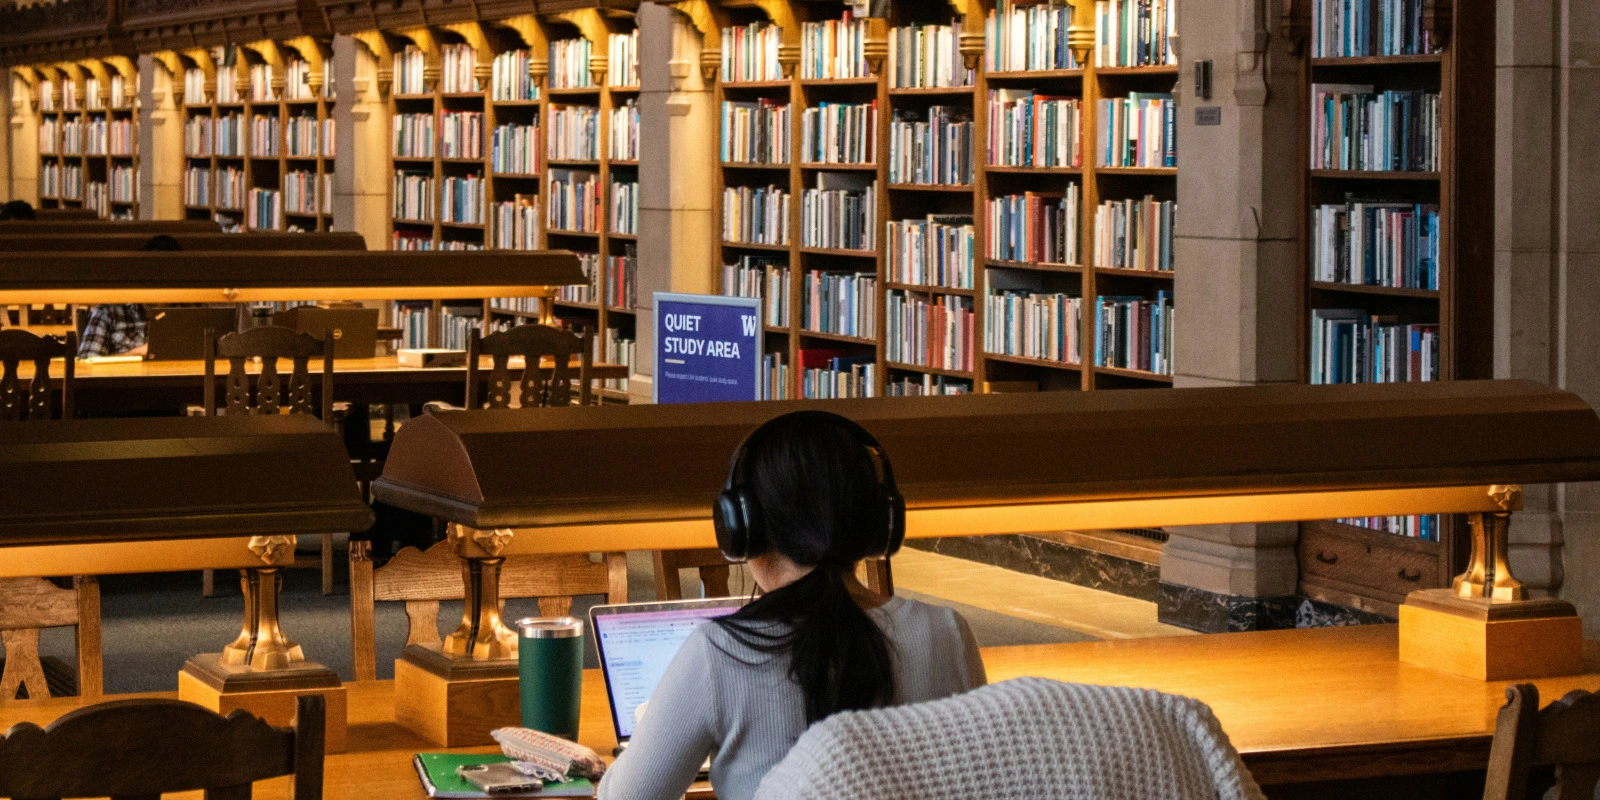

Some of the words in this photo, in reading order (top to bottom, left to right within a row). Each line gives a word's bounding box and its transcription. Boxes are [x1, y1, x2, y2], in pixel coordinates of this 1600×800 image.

[665, 313, 701, 332] QUIET
[741, 315, 756, 337] W
[665, 337, 705, 356] STUDY
[706, 341, 741, 359] AREA
